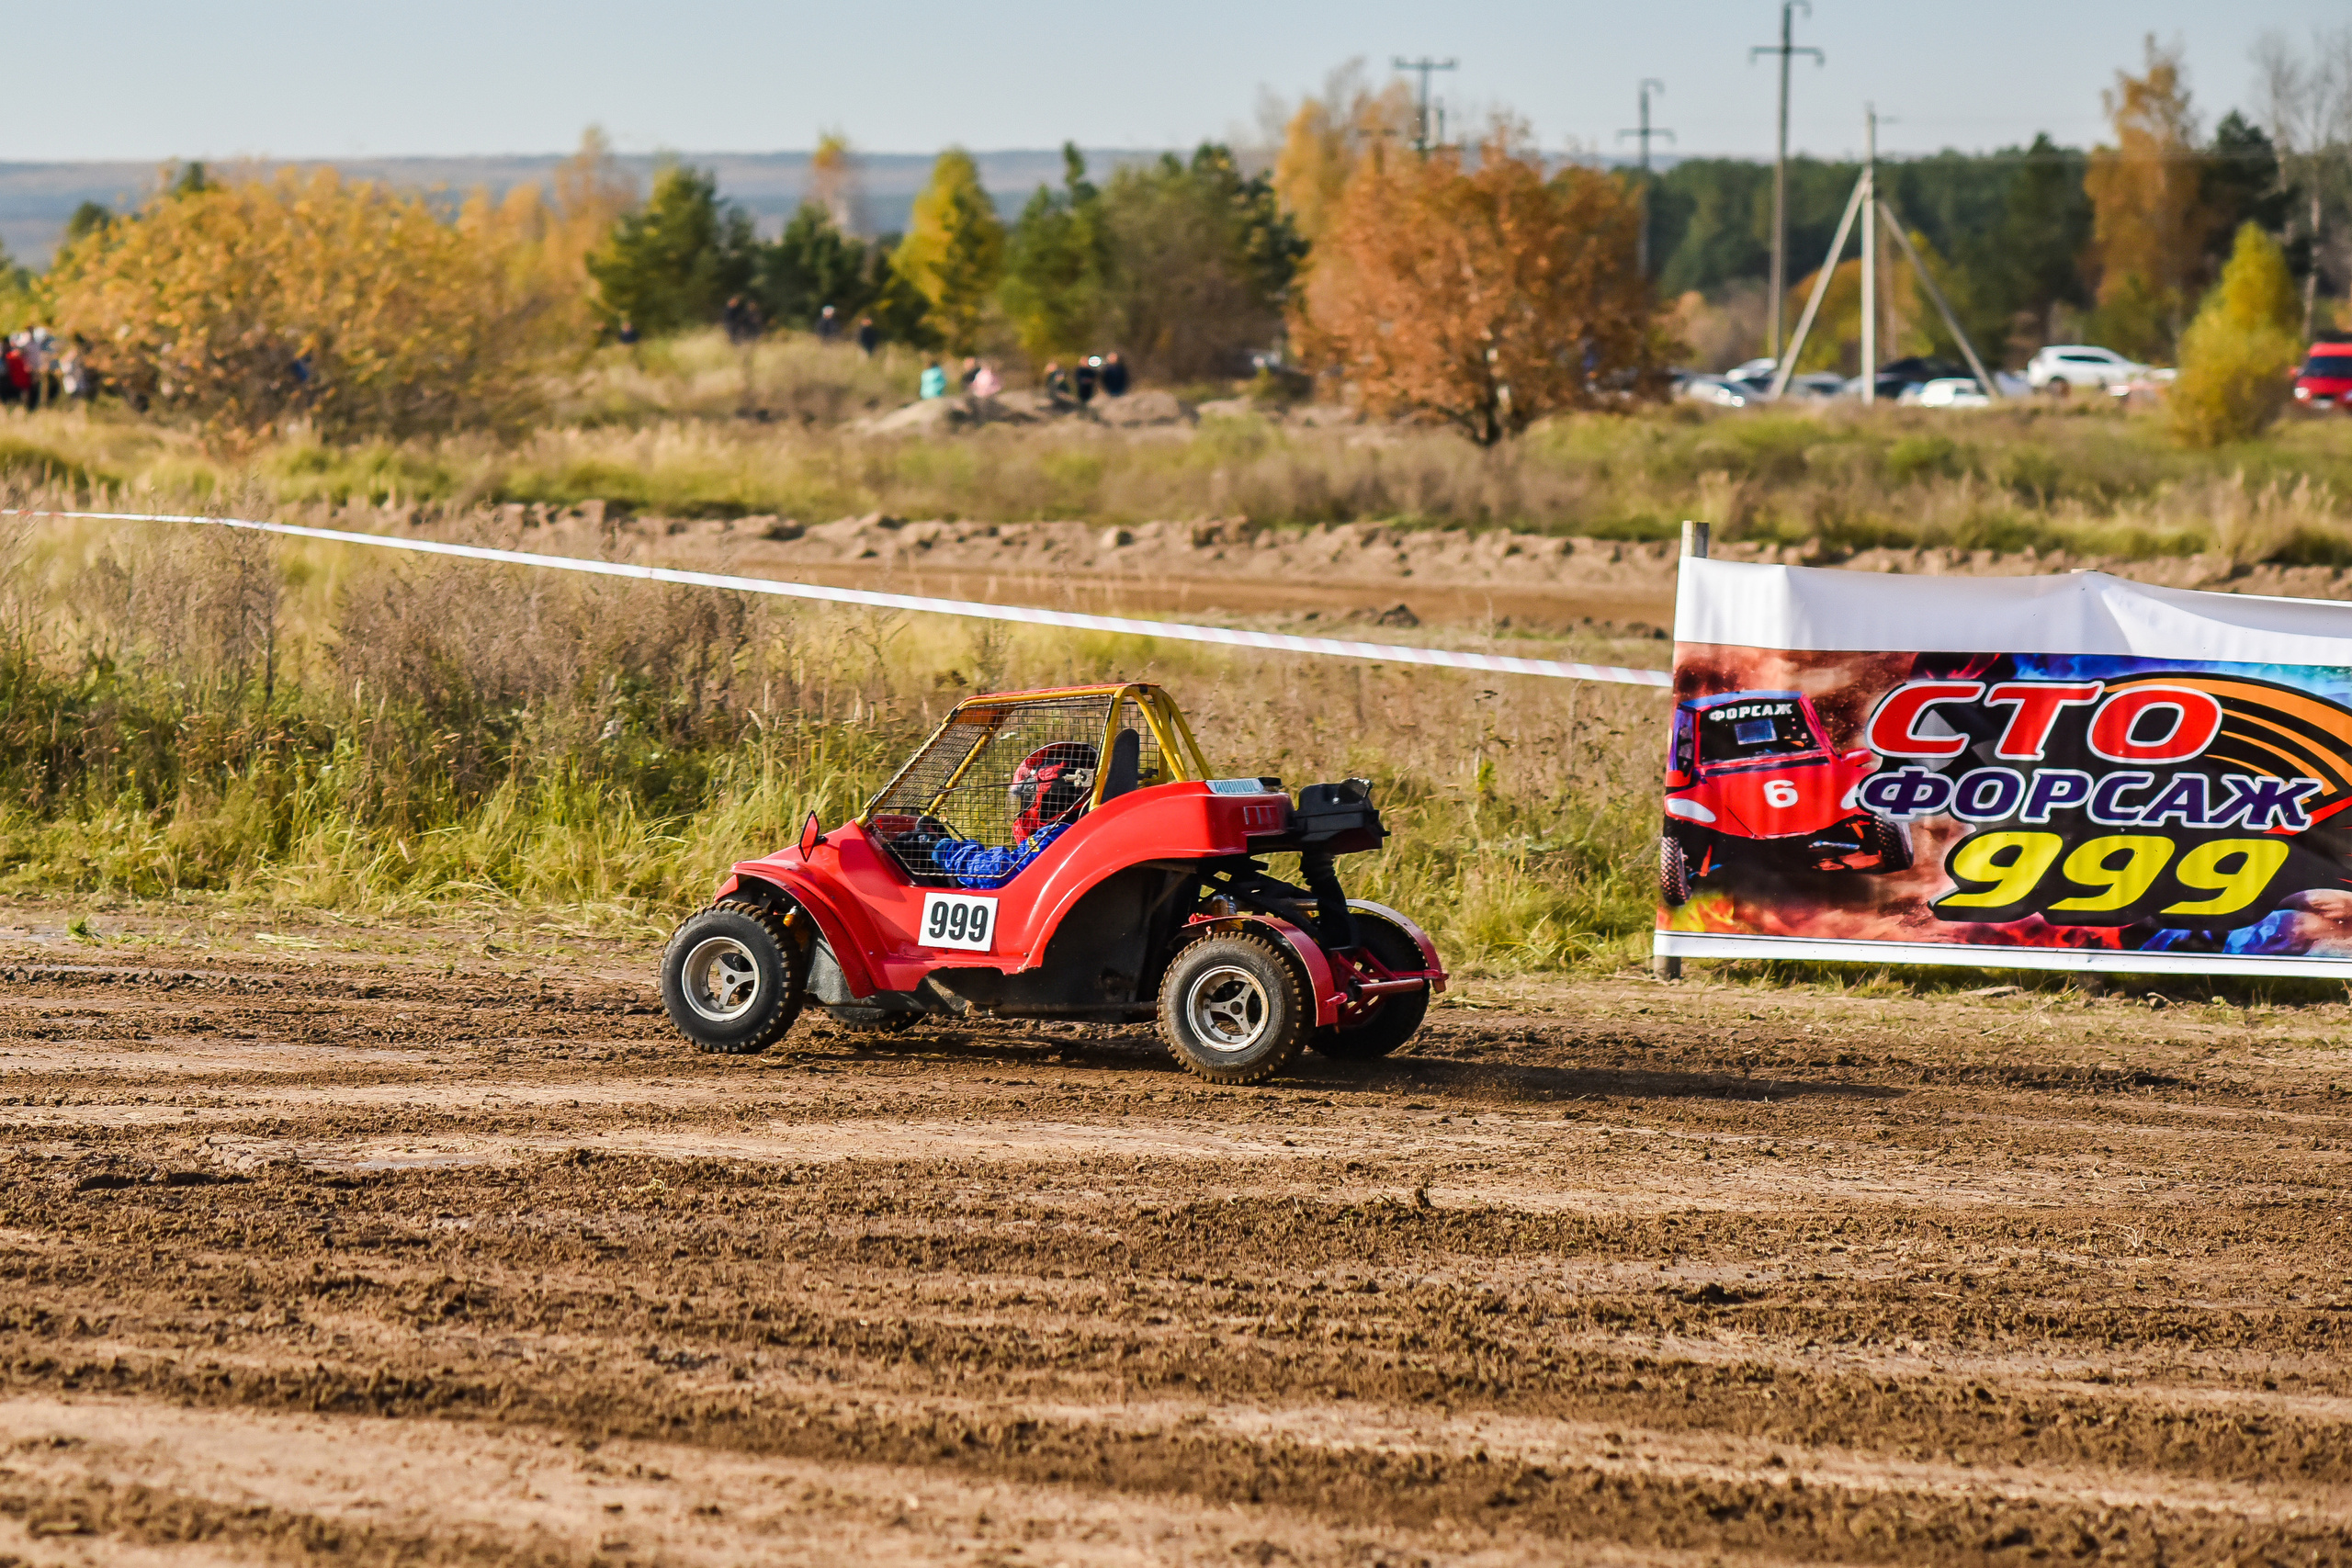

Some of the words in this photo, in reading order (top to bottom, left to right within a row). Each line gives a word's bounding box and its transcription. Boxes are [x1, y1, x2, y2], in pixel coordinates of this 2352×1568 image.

[1709, 704, 1792, 721] ФОРСАЖ
[1867, 681, 2222, 762] СТО
[1763, 780, 1799, 808] 6
[1860, 766, 2323, 830] ФОРСАЖ
[1938, 831, 2290, 916] 999
[928, 901, 989, 942] 999
